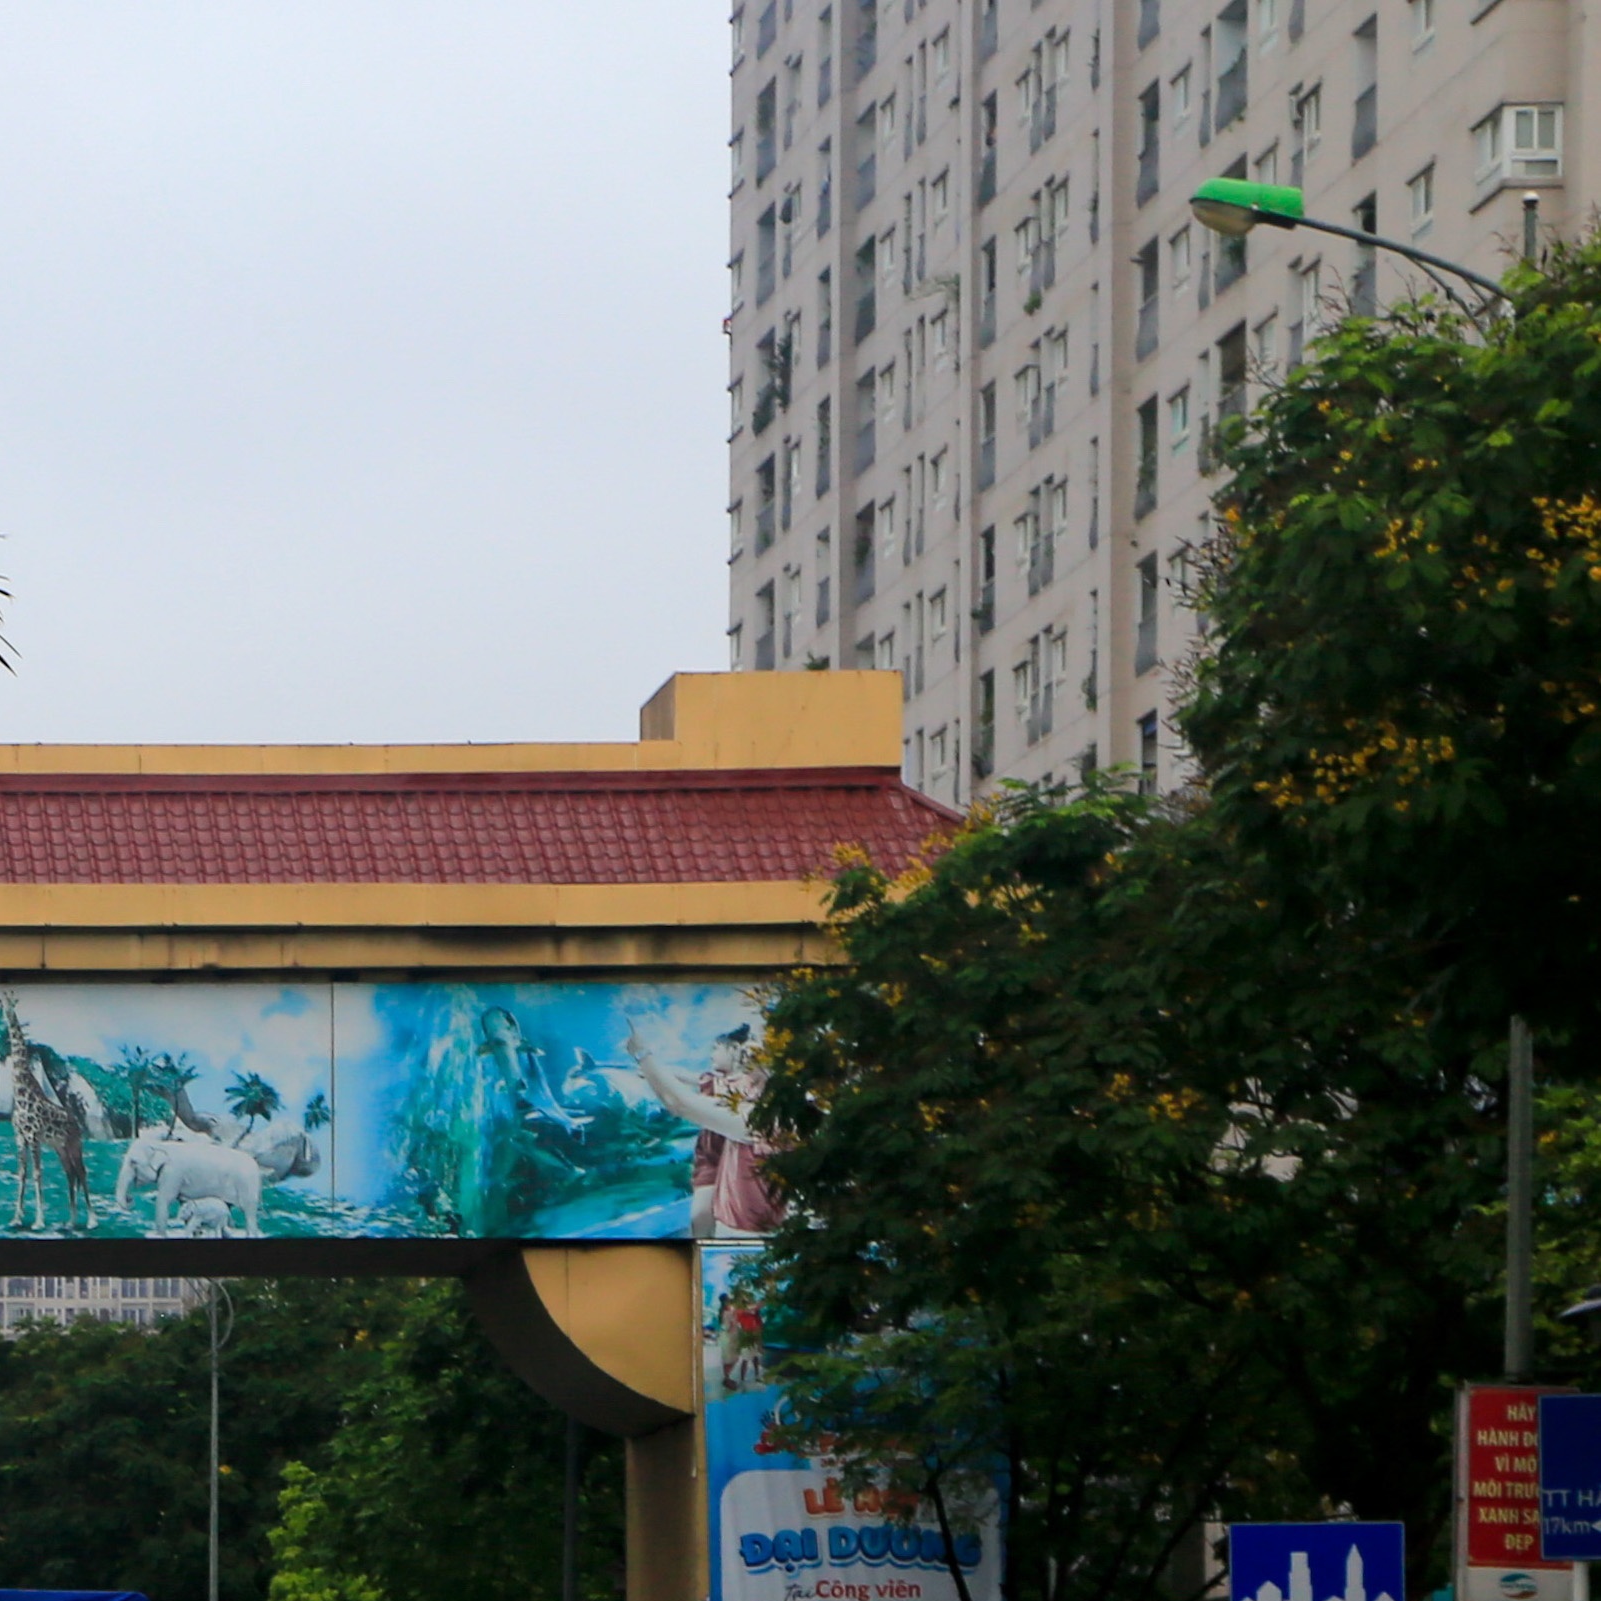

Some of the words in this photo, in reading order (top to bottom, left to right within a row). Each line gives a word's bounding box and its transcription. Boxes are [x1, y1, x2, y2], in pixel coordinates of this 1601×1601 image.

[1477, 1427, 1519, 1447] HÀNH
[1494, 1452, 1510, 1472] VÌ
[1513, 1454, 1538, 1476] MỘ
[1473, 1478, 1502, 1498] MÔI
[1478, 1507, 1519, 1525] XANH
[740, 1527, 819, 1573] ĐẠI
[876, 1579, 921, 1598] viên
